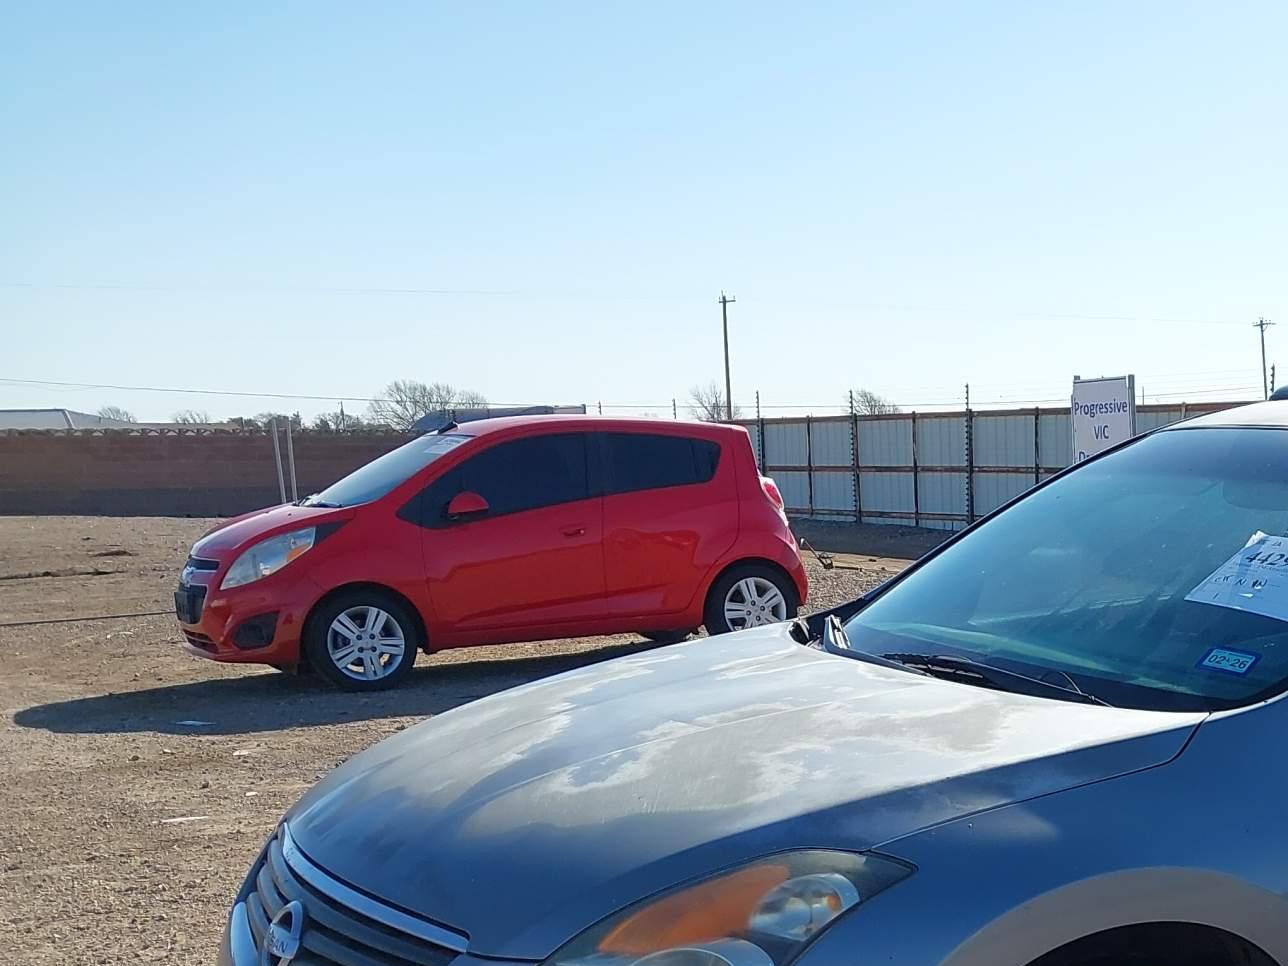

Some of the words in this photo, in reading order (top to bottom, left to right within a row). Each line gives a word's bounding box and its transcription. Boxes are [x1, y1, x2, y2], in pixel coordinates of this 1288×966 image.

[1074, 399, 1128, 418] Progressive
[1093, 424, 1110, 440] VIC
[1208, 654, 1227, 665] 02
[1229, 658, 1249, 669] 26
